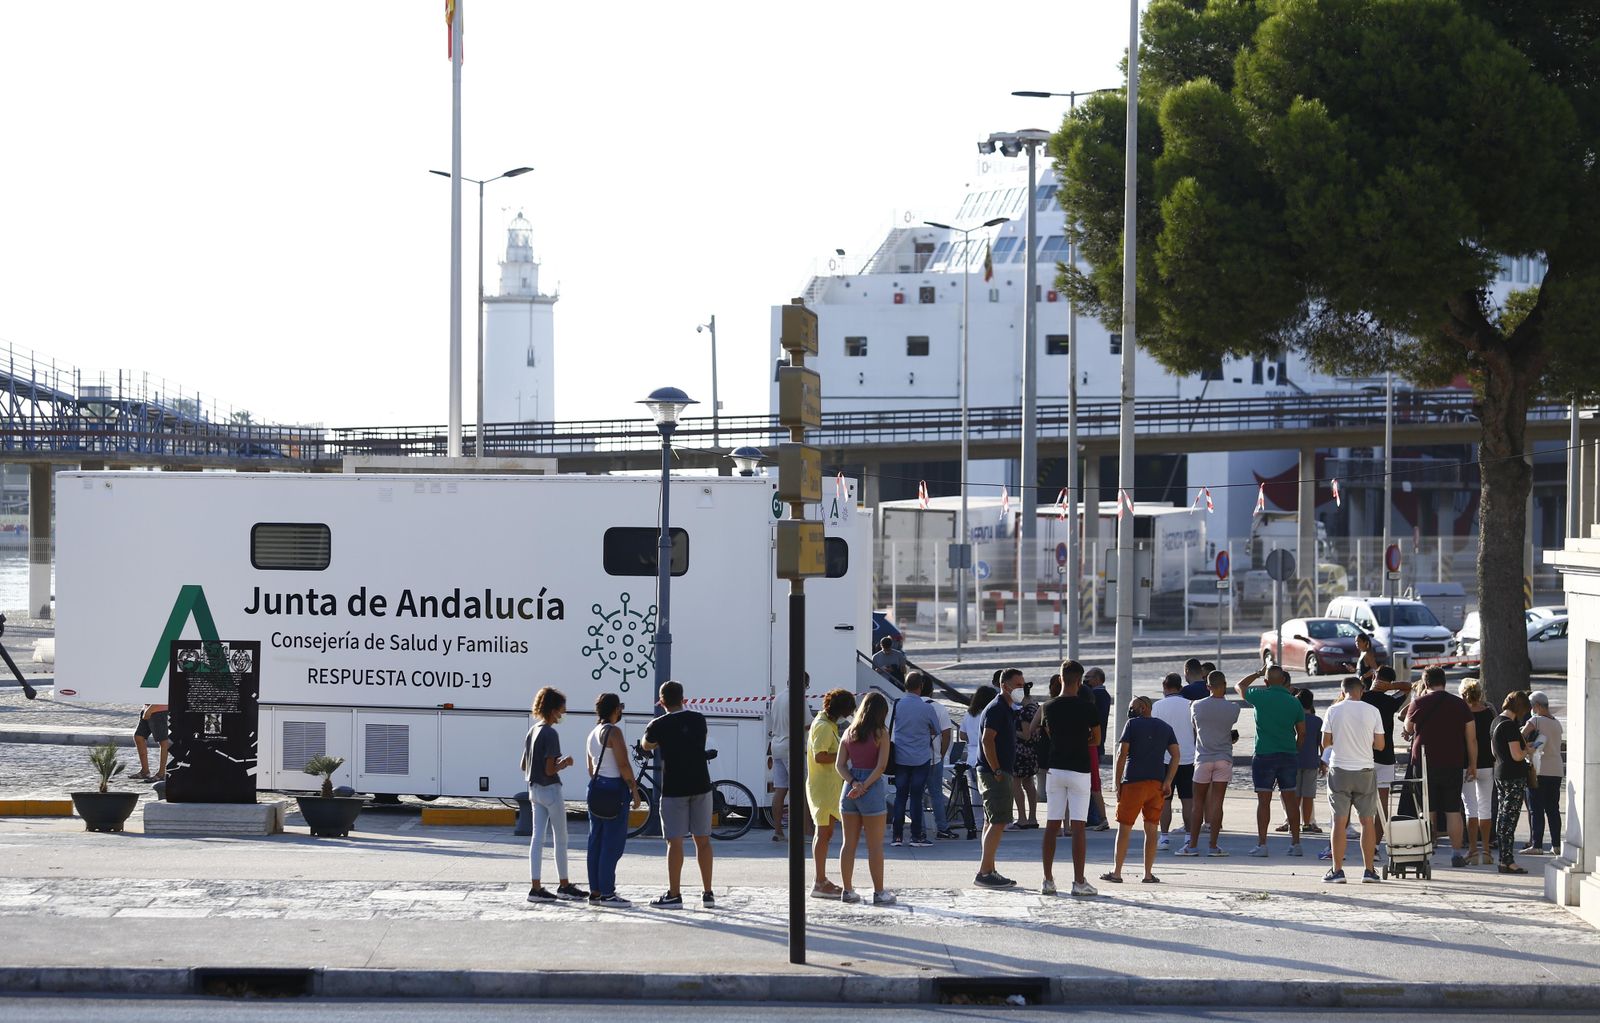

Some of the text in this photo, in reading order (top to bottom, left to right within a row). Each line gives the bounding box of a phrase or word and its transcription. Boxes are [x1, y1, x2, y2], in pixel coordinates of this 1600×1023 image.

[243, 586, 565, 620] Junta de Andalucía
[271, 630, 529, 656] Consejería de Salud y Familias
[307, 667, 492, 689] RESPUESTA COVID-19
